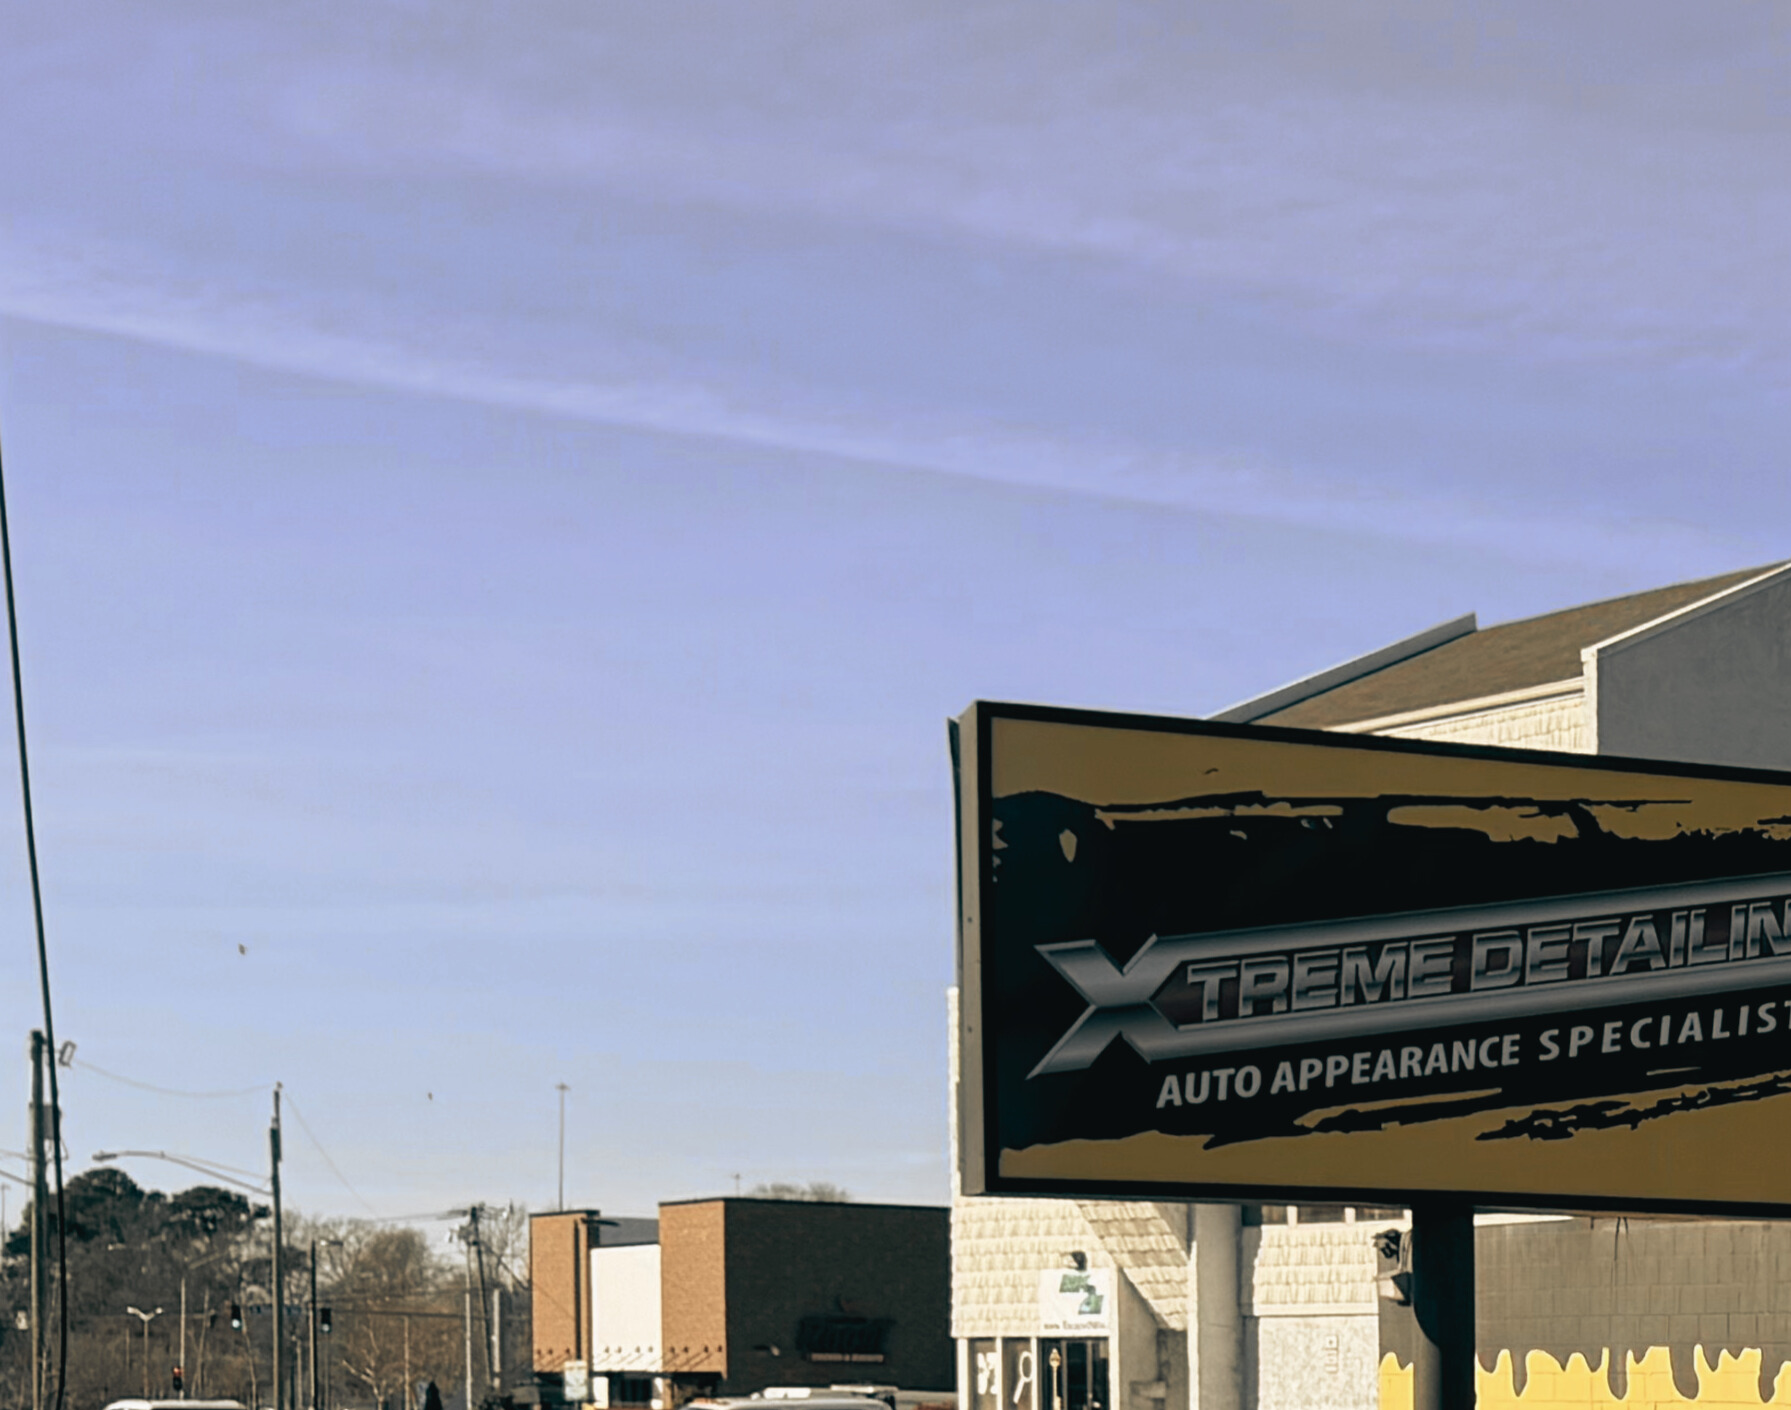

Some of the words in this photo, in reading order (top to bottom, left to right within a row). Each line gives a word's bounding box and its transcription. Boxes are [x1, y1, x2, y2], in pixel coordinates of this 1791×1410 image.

[1026, 933, 1456, 1080] XTREME
[1156, 1065, 1261, 1108] AUTO
[1270, 1034, 1521, 1094] APPEARANCE
